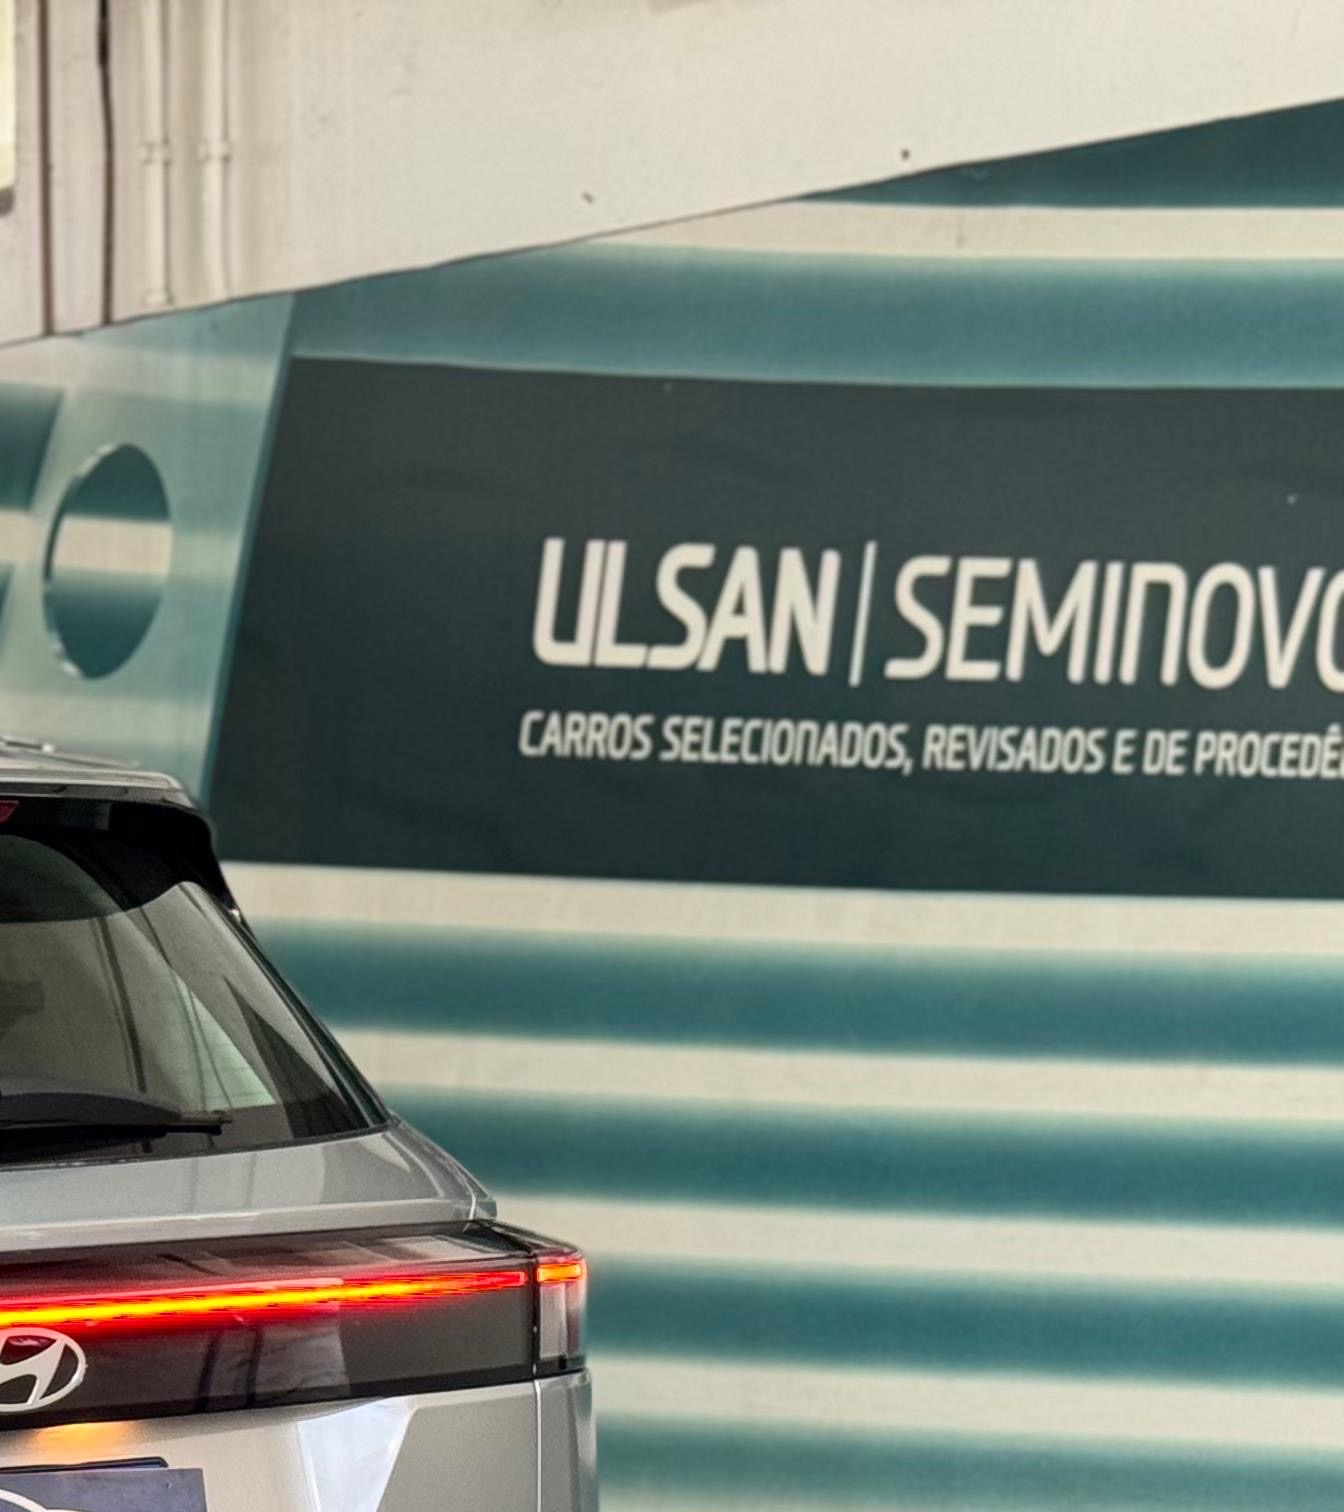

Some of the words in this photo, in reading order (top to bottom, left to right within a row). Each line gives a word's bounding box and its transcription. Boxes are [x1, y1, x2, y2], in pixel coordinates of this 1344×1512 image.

[532, 537, 841, 676] ULSAN
[518, 710, 655, 761] CARROS
[659, 715, 913, 775] SELECIONADOS,
[921, 723, 1108, 775] REVISADOS
[1112, 728, 1138, 775] E
[1142, 729, 1190, 776] DE
[1194, 723, 1344, 779] PROCEDÊ
